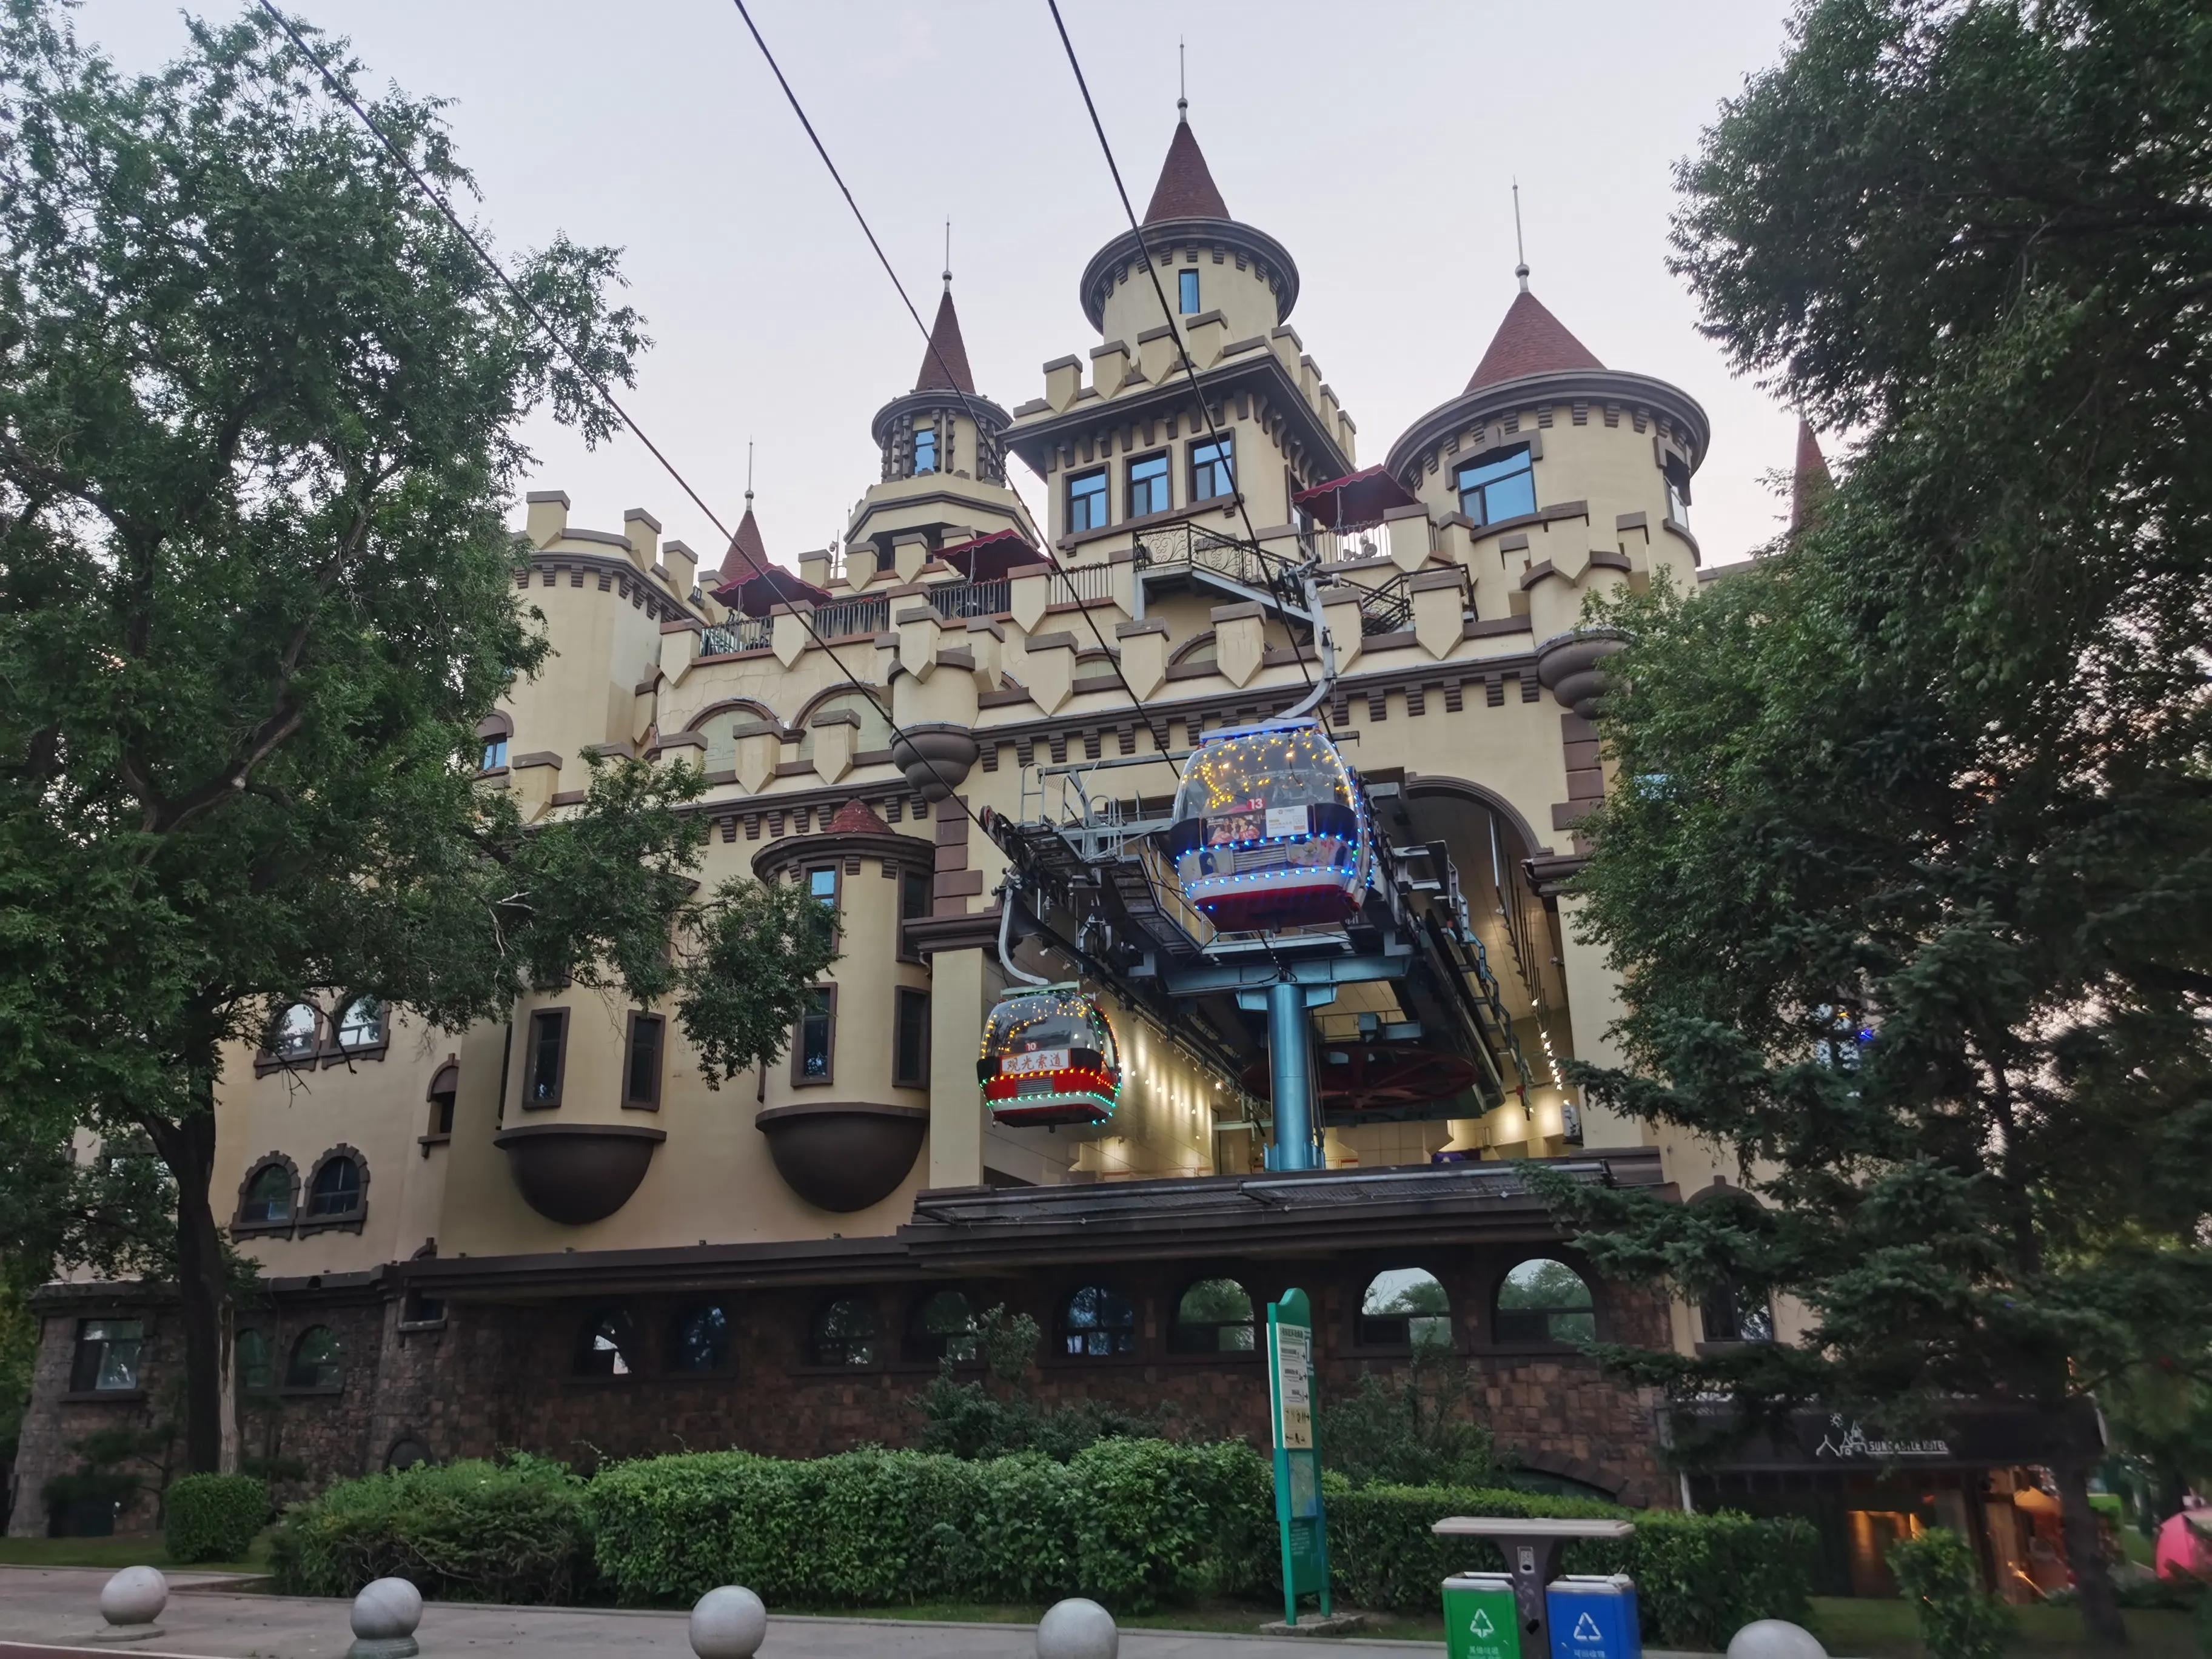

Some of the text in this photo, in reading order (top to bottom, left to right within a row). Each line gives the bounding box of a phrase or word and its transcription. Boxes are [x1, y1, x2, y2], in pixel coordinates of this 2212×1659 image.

[1249, 799, 1263, 809] 13
[1027, 1042, 1036, 1051] 10
[1007, 1052, 1063, 1071] 观光索道
[1922, 1440, 1948, 1450] HOTEL
